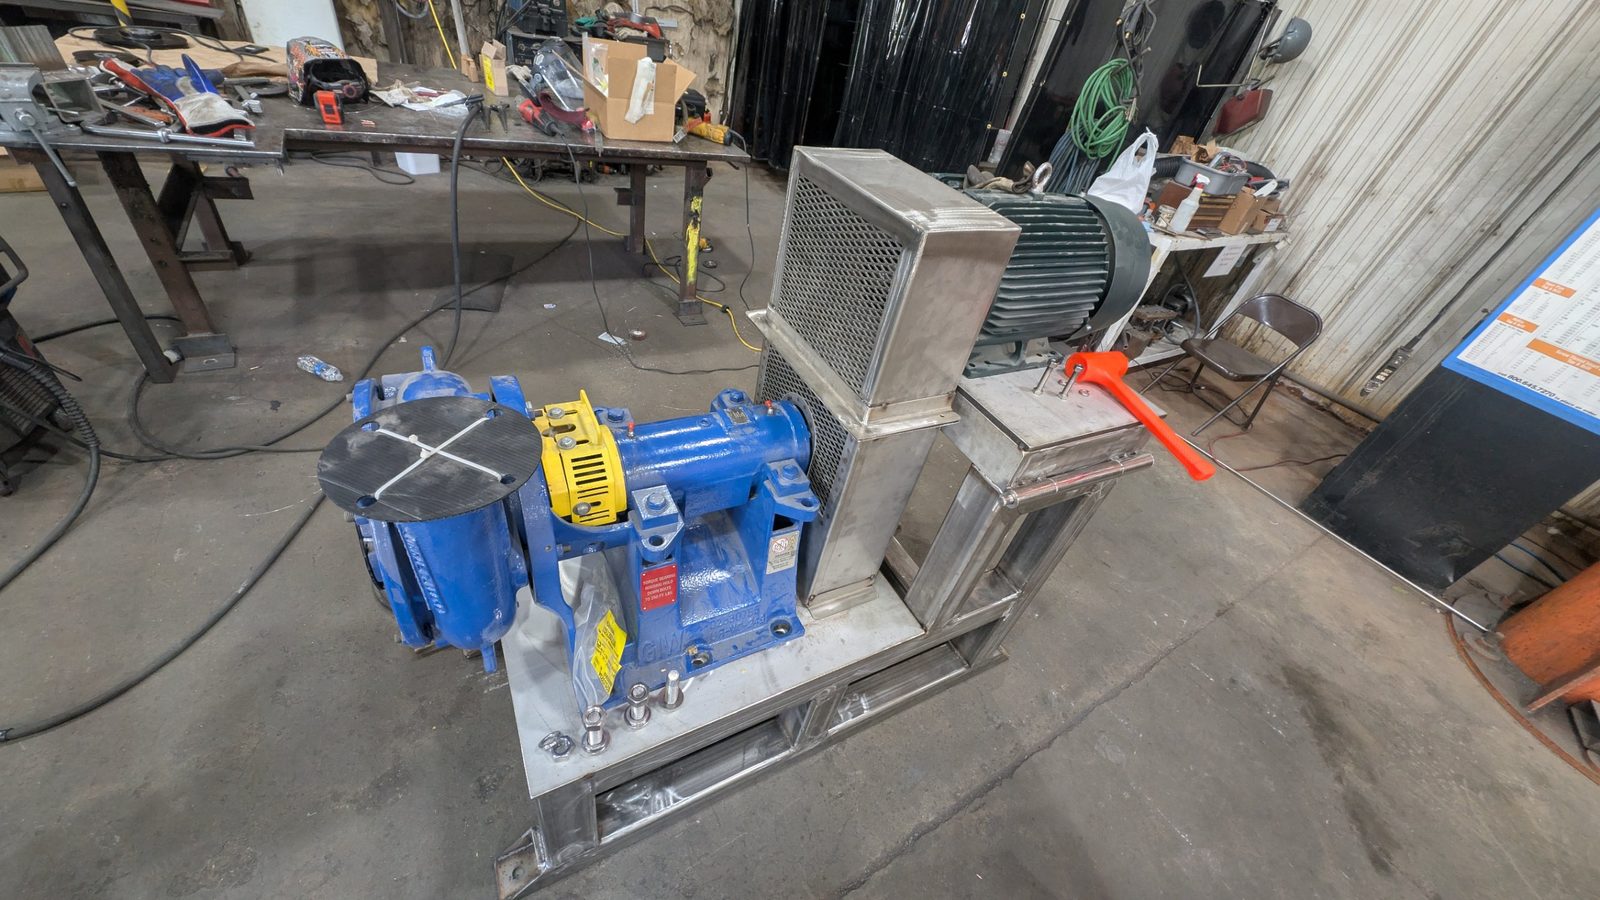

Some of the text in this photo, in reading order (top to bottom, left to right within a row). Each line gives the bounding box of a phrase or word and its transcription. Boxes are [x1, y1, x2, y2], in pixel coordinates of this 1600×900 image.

[659, 573, 676, 582] BEARING
[647, 585, 672, 596] DOWN BOLTS
